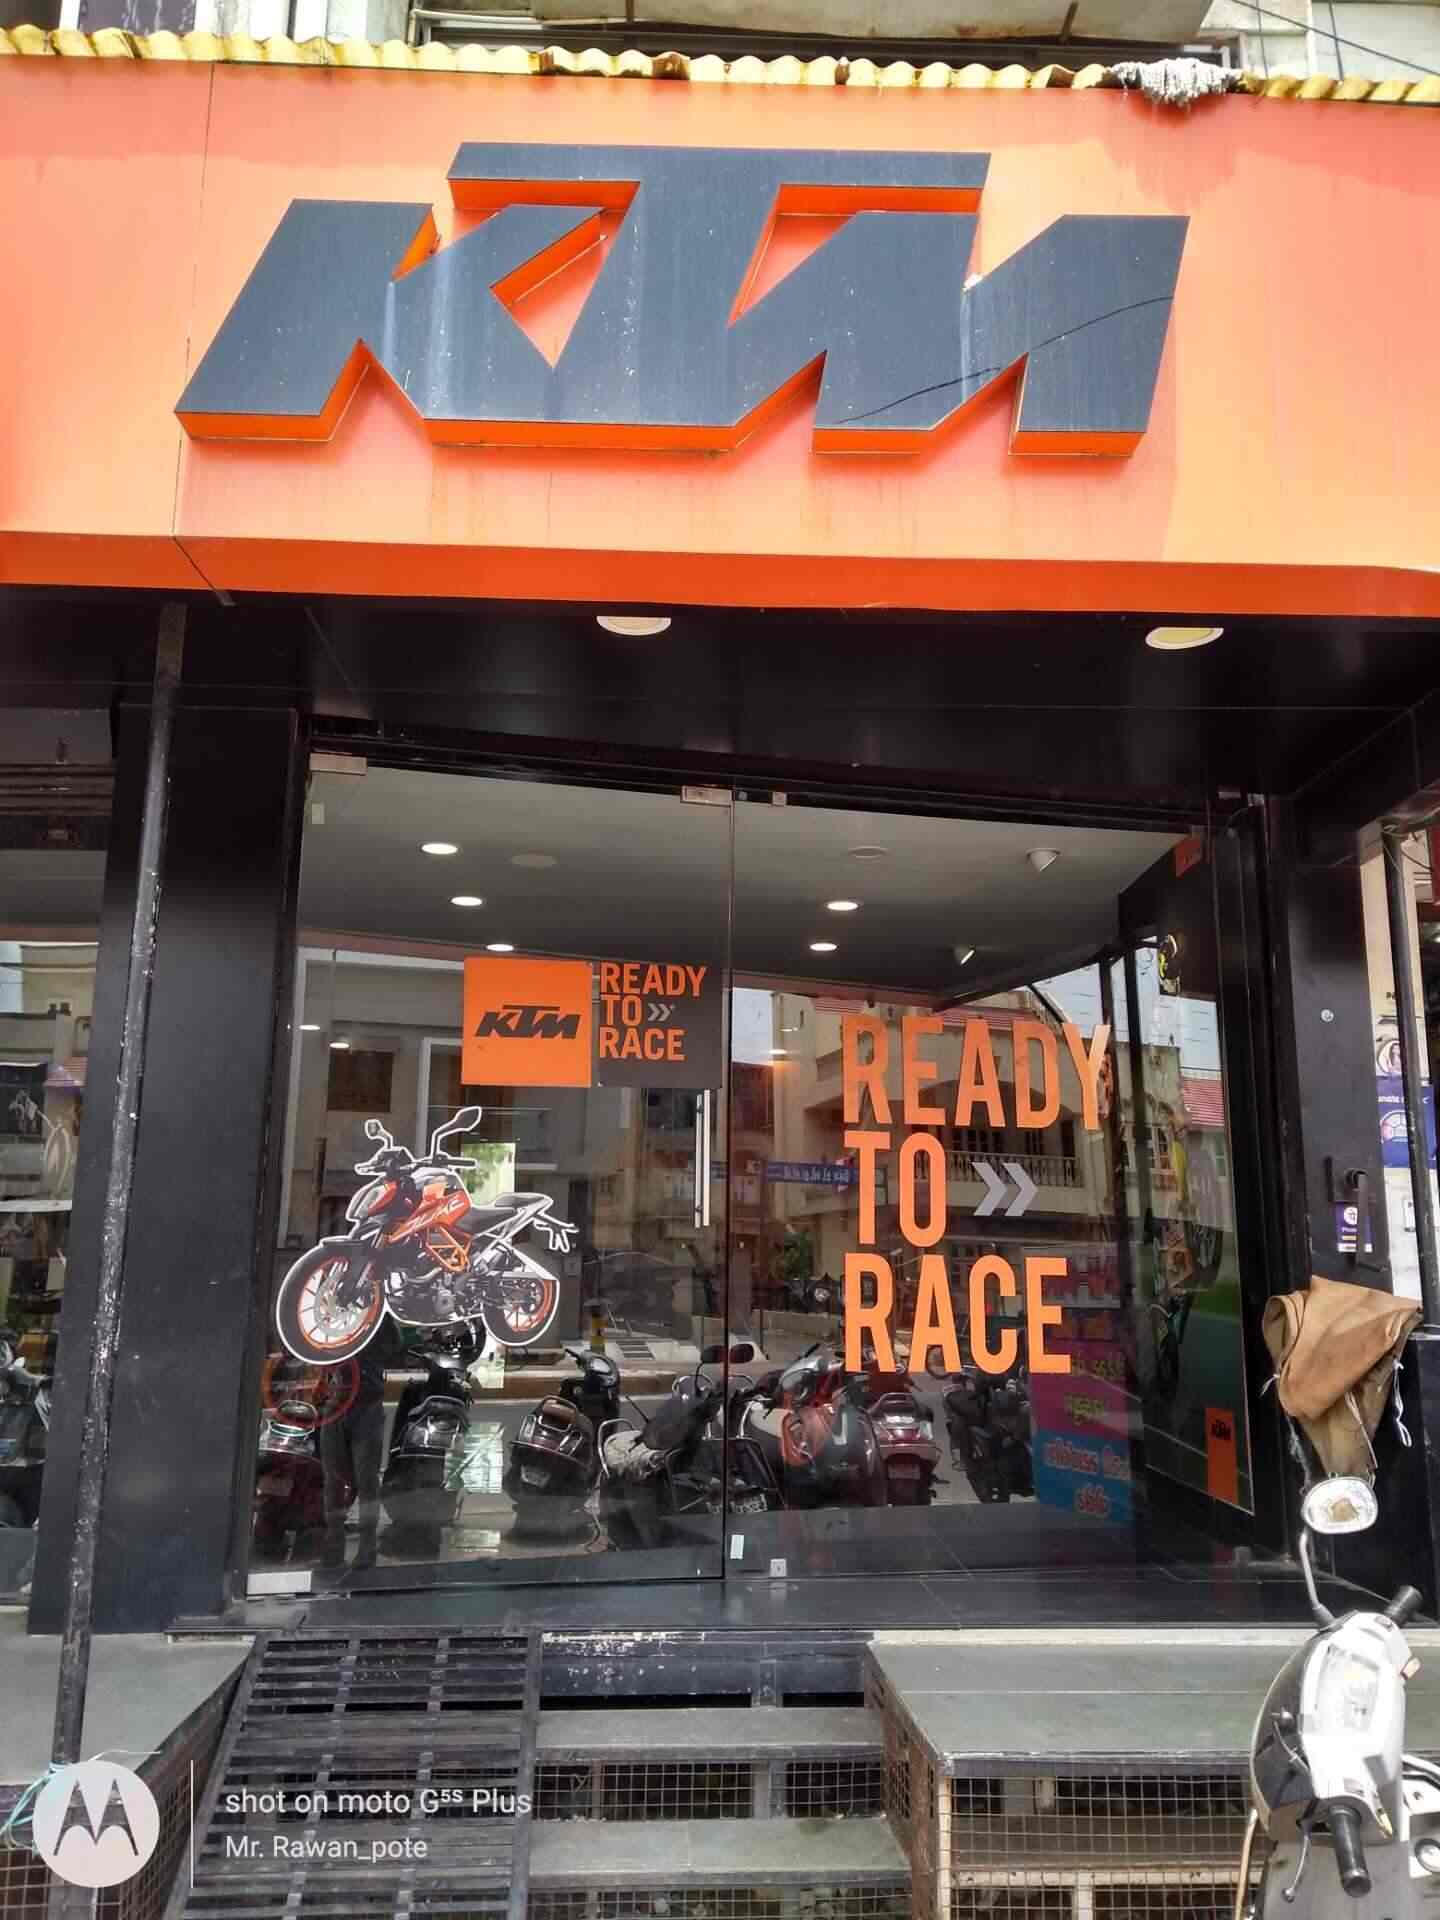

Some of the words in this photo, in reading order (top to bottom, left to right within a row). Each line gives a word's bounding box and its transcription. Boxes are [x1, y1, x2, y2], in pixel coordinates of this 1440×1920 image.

[175, 142, 1189, 435] KTM
[600, 962, 707, 996] READY
[600, 995, 643, 1026] TO
[475, 1004, 582, 1039] KTM
[599, 1027, 686, 1061] RACE
[841, 1014, 1112, 1130] READY
[844, 1131, 947, 1247] TO
[843, 1253, 1072, 1375] RACE
